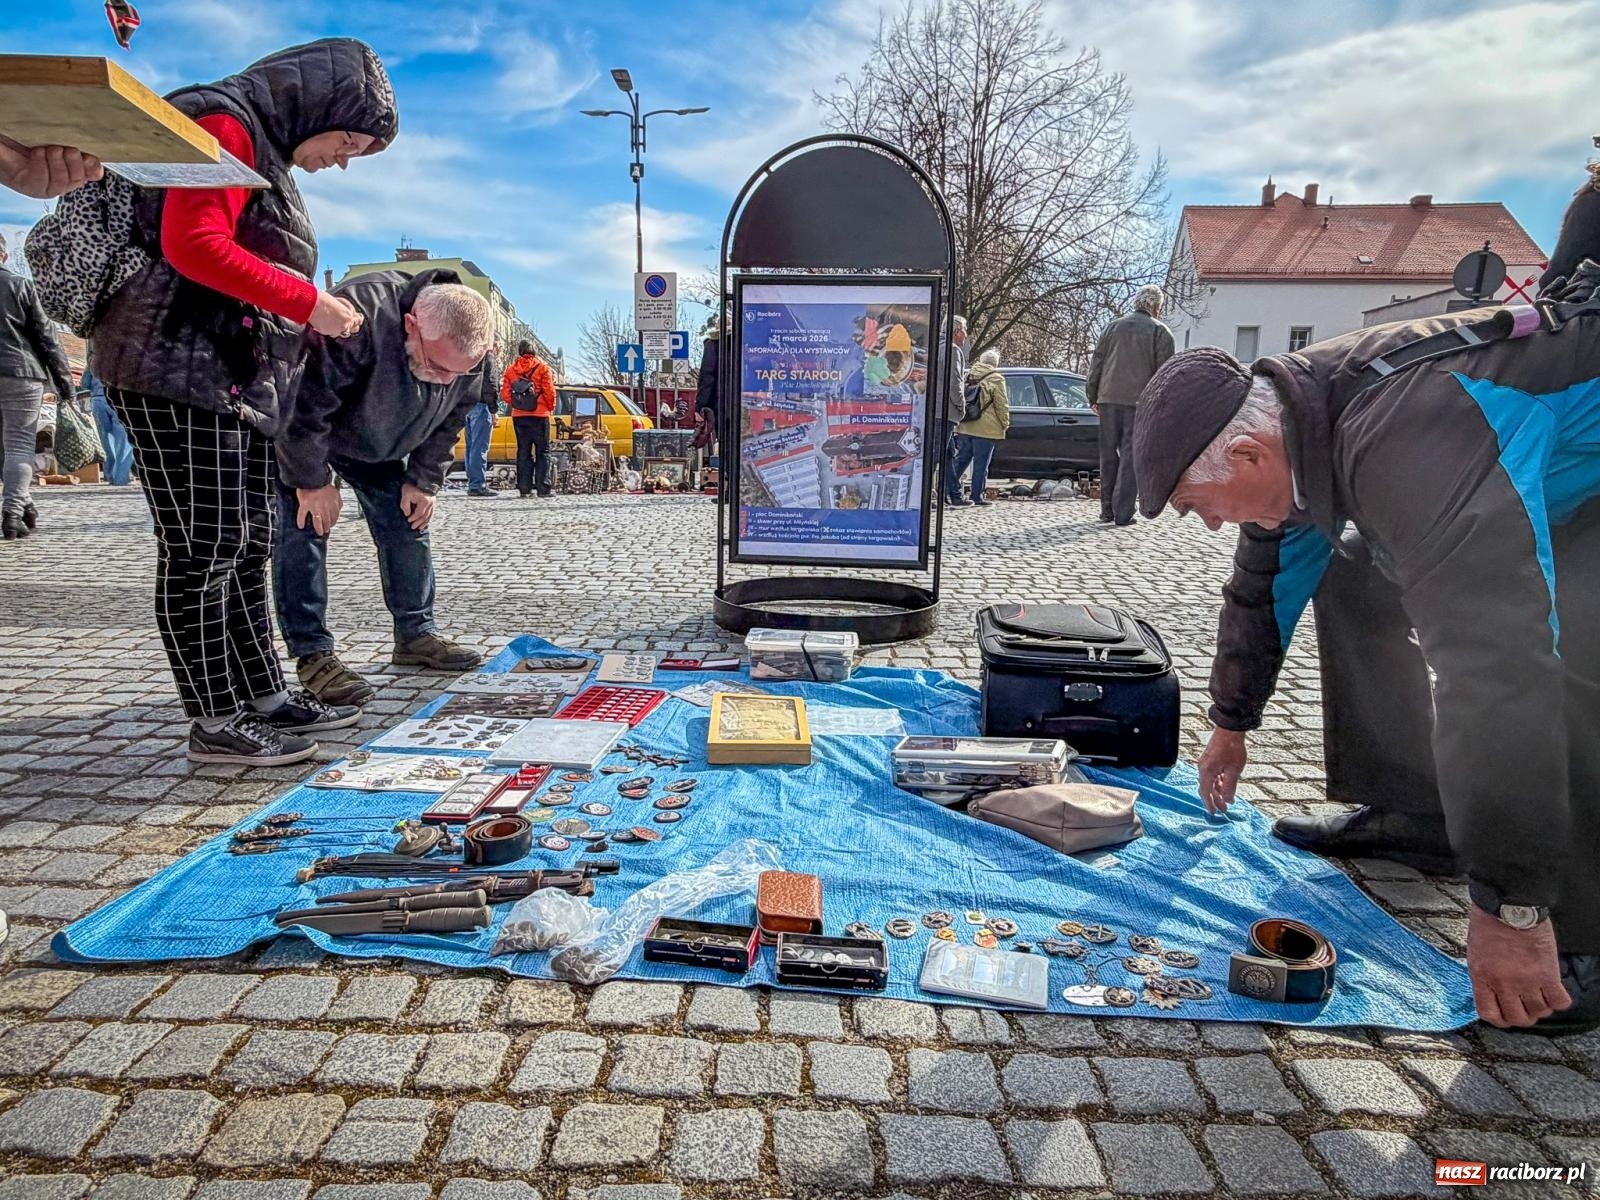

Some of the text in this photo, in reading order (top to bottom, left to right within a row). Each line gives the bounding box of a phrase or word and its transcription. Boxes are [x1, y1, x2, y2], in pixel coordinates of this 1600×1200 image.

[772, 334, 781, 342] 21
[809, 334, 829, 342] 2026
[790, 346, 803, 355] DLA
[804, 345, 850, 355] WYSTAWCÓW
[755, 369, 842, 381] TARG STAROCI
[851, 415, 909, 424] pl. Dominikański
